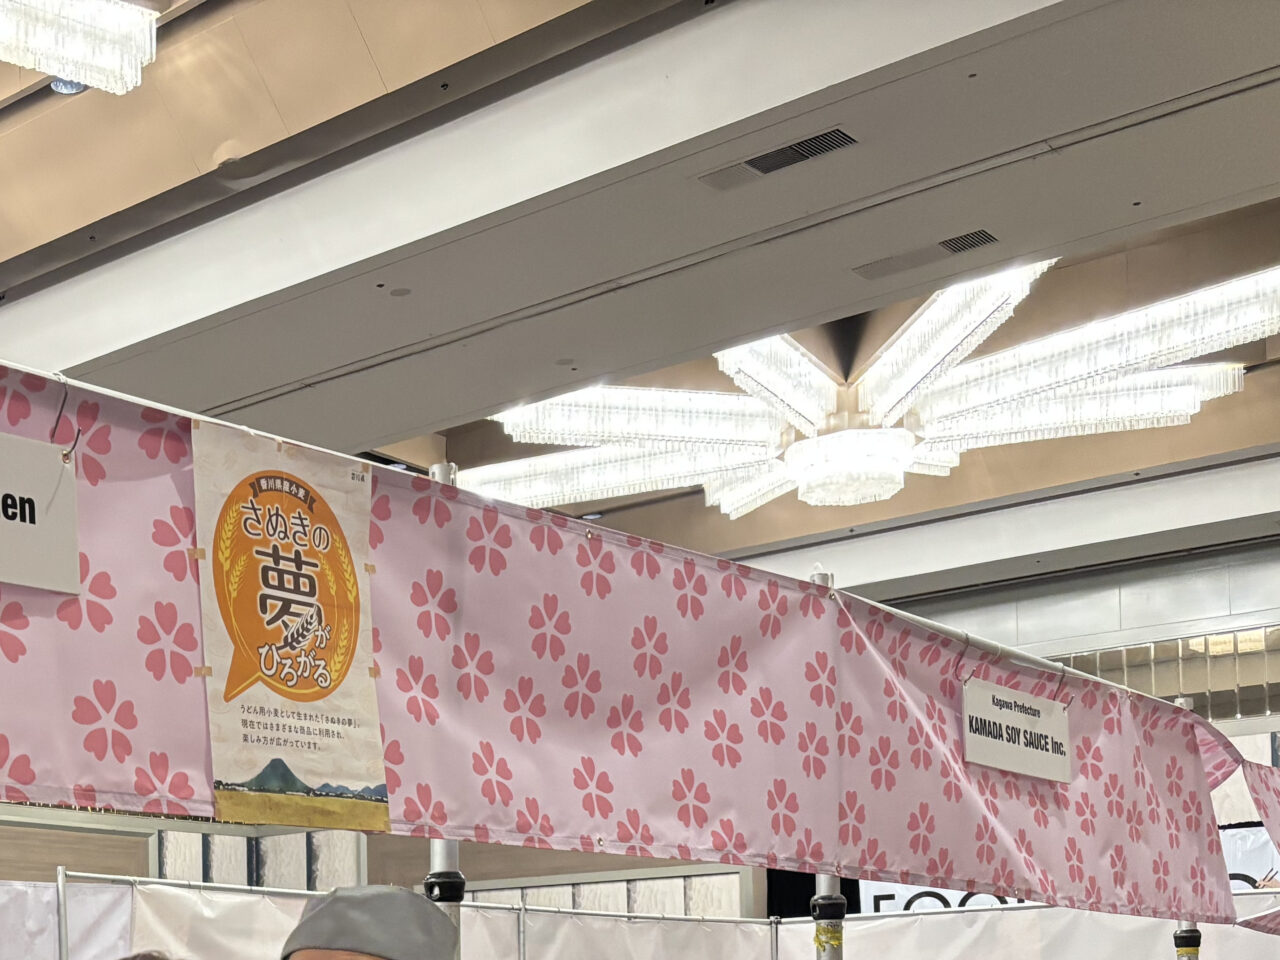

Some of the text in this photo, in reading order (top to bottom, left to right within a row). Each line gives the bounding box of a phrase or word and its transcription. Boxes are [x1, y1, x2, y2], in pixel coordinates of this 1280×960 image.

[260, 477, 307, 501] 香川県産小麦
[241, 498, 330, 551] さぬきの
[992, 695, 1041, 718] Kagawa Prefecture
[968, 715, 1066, 757] KAMADA SOY SAUCE Inc.
